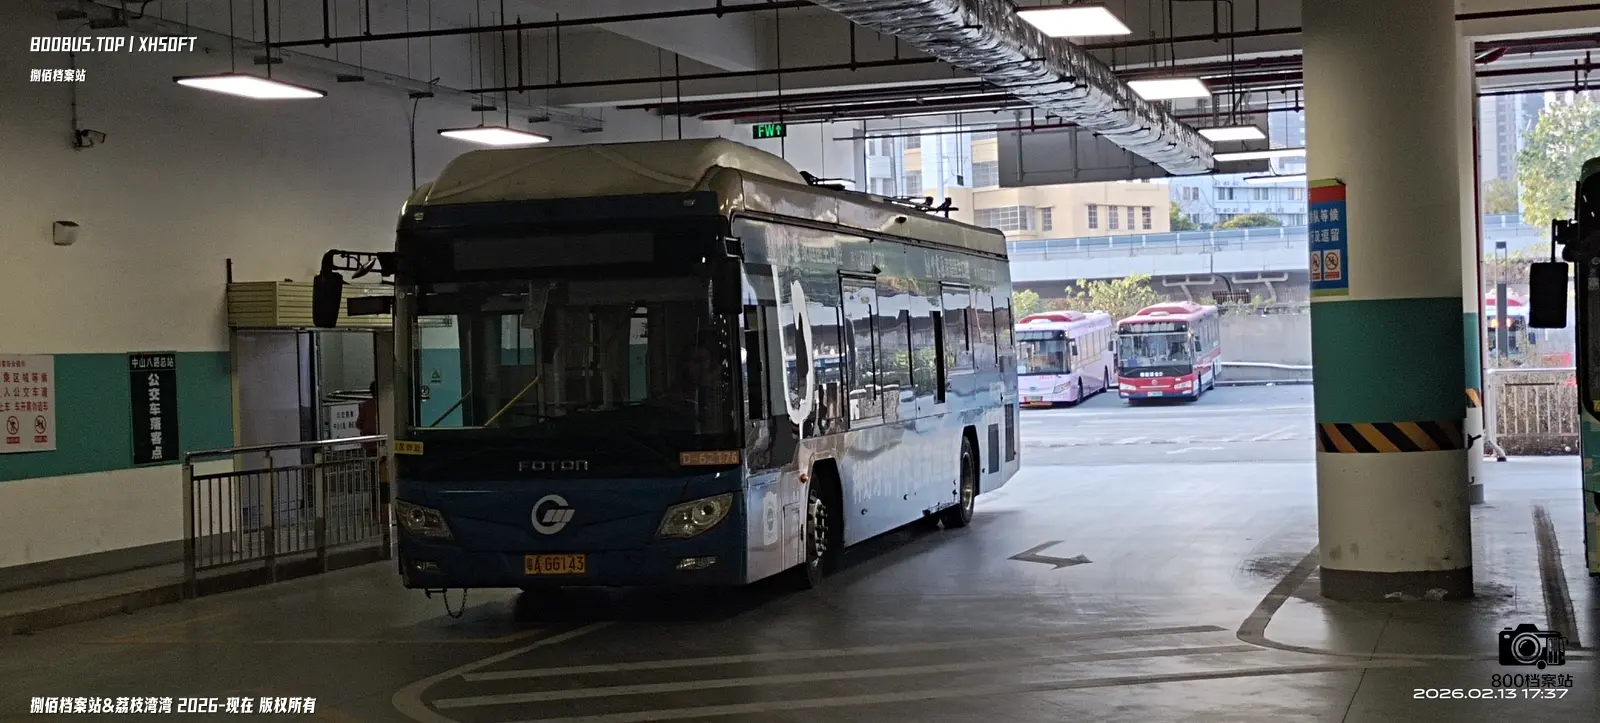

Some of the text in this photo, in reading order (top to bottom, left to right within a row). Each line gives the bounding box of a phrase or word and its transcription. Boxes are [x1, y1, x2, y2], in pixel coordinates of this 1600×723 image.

[132, 356, 174, 369] 中山八路总站
[0, 372, 48, 383] 乘区域等候
[0, 387, 48, 398] 入公交车道
[147, 372, 165, 461] 公交车落客点
[517, 459, 589, 473] FOTON
